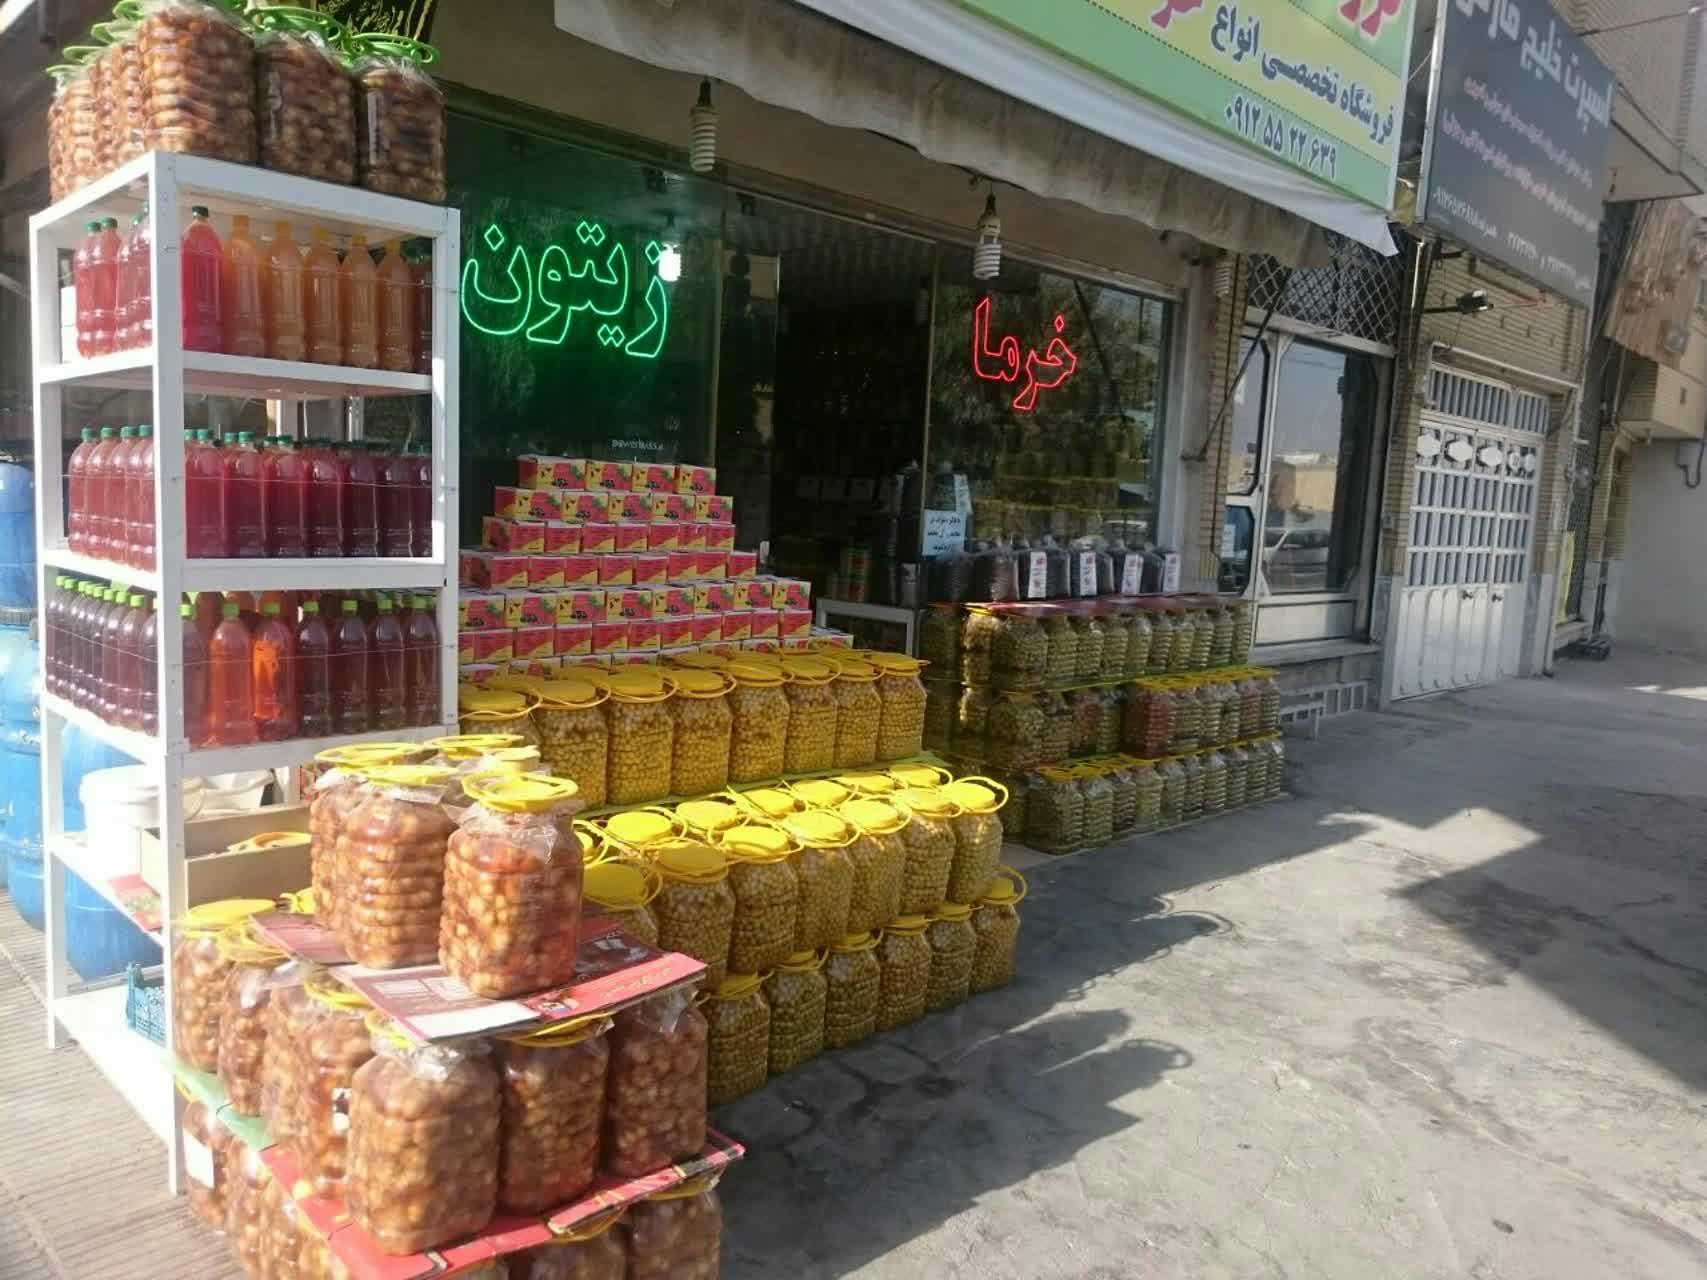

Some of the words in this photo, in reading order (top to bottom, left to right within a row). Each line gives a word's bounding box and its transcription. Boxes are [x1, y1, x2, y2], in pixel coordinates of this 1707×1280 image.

[1210, 5, 1260, 62] انواع
[1520, 20, 1562, 82] خلیج
[1261, 52, 1339, 104] تخصصی
[1225, 96, 1261, 138] ۰۹۱۲
[1263, 114, 1283, 152] ۵۵
[1341, 83, 1394, 145] فروشگاه
[461, 221, 668, 358] زیتون
[973, 297, 1077, 411] خرما
